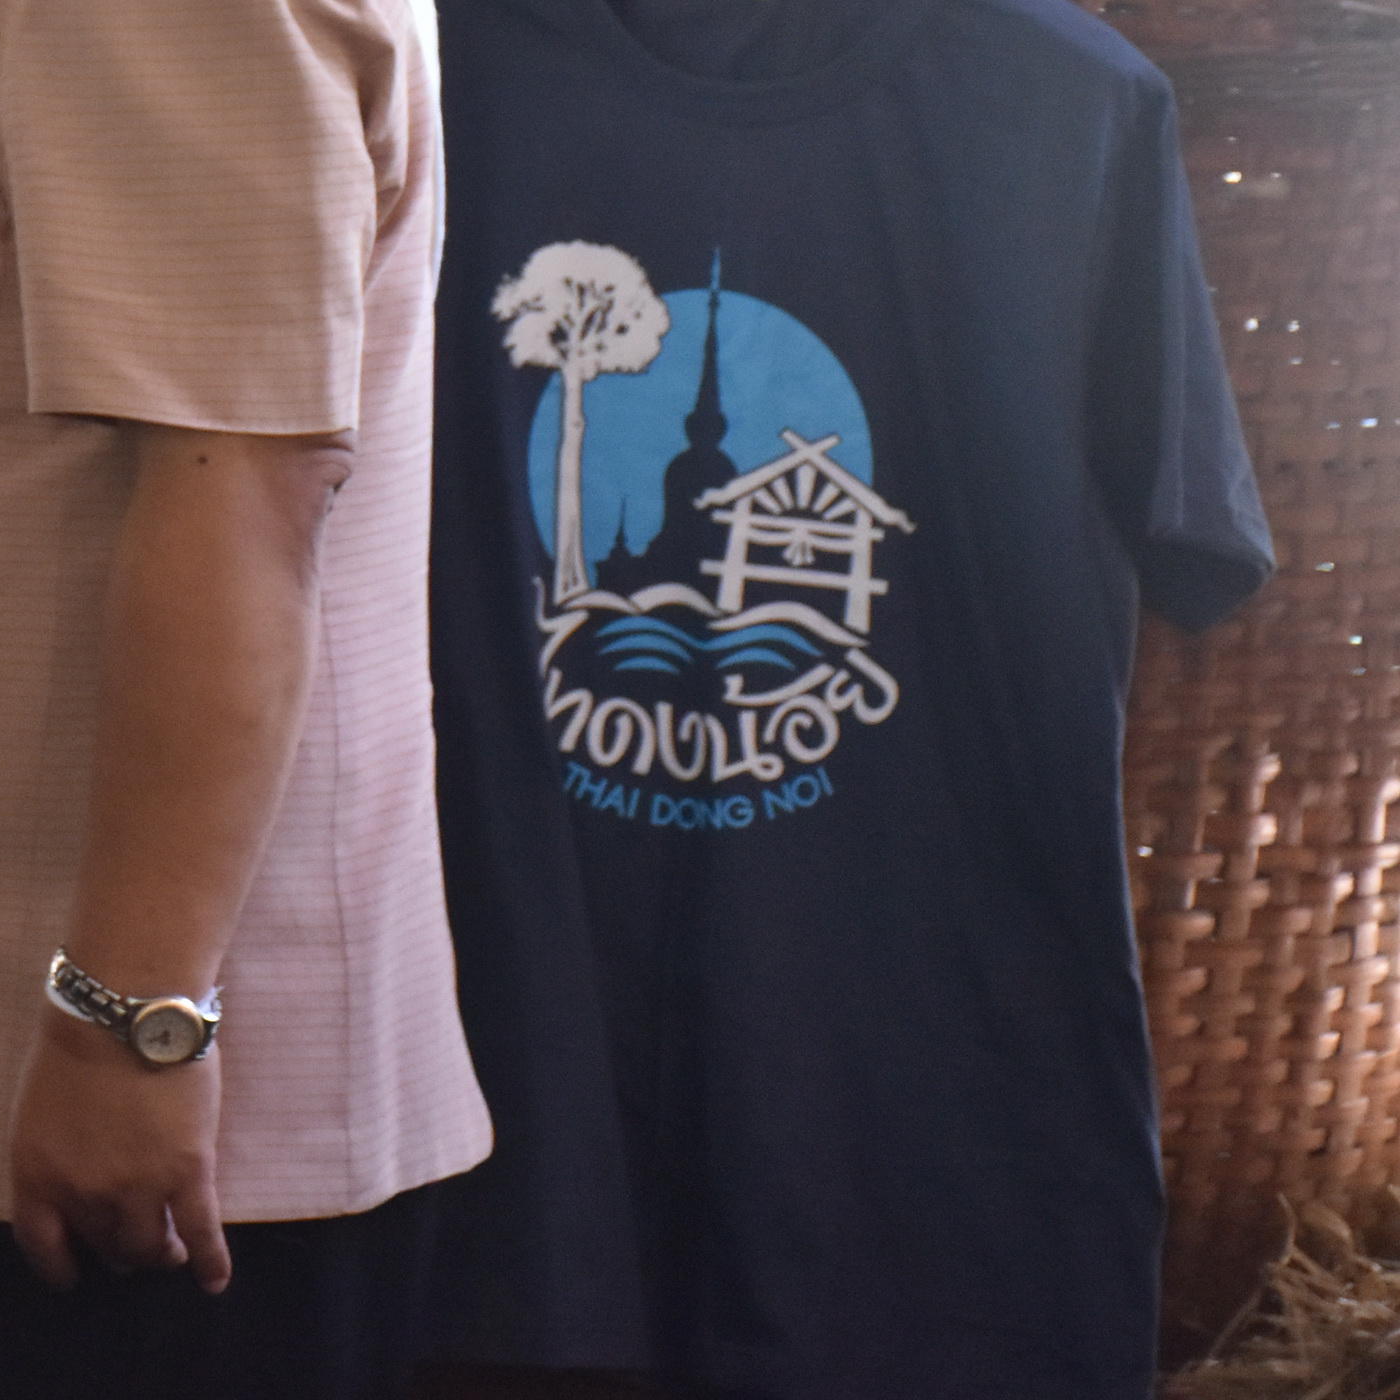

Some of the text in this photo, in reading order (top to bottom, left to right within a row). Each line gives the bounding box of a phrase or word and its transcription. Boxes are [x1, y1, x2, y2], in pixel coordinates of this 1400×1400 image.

[562, 760, 835, 831] THAI DONG NOI
